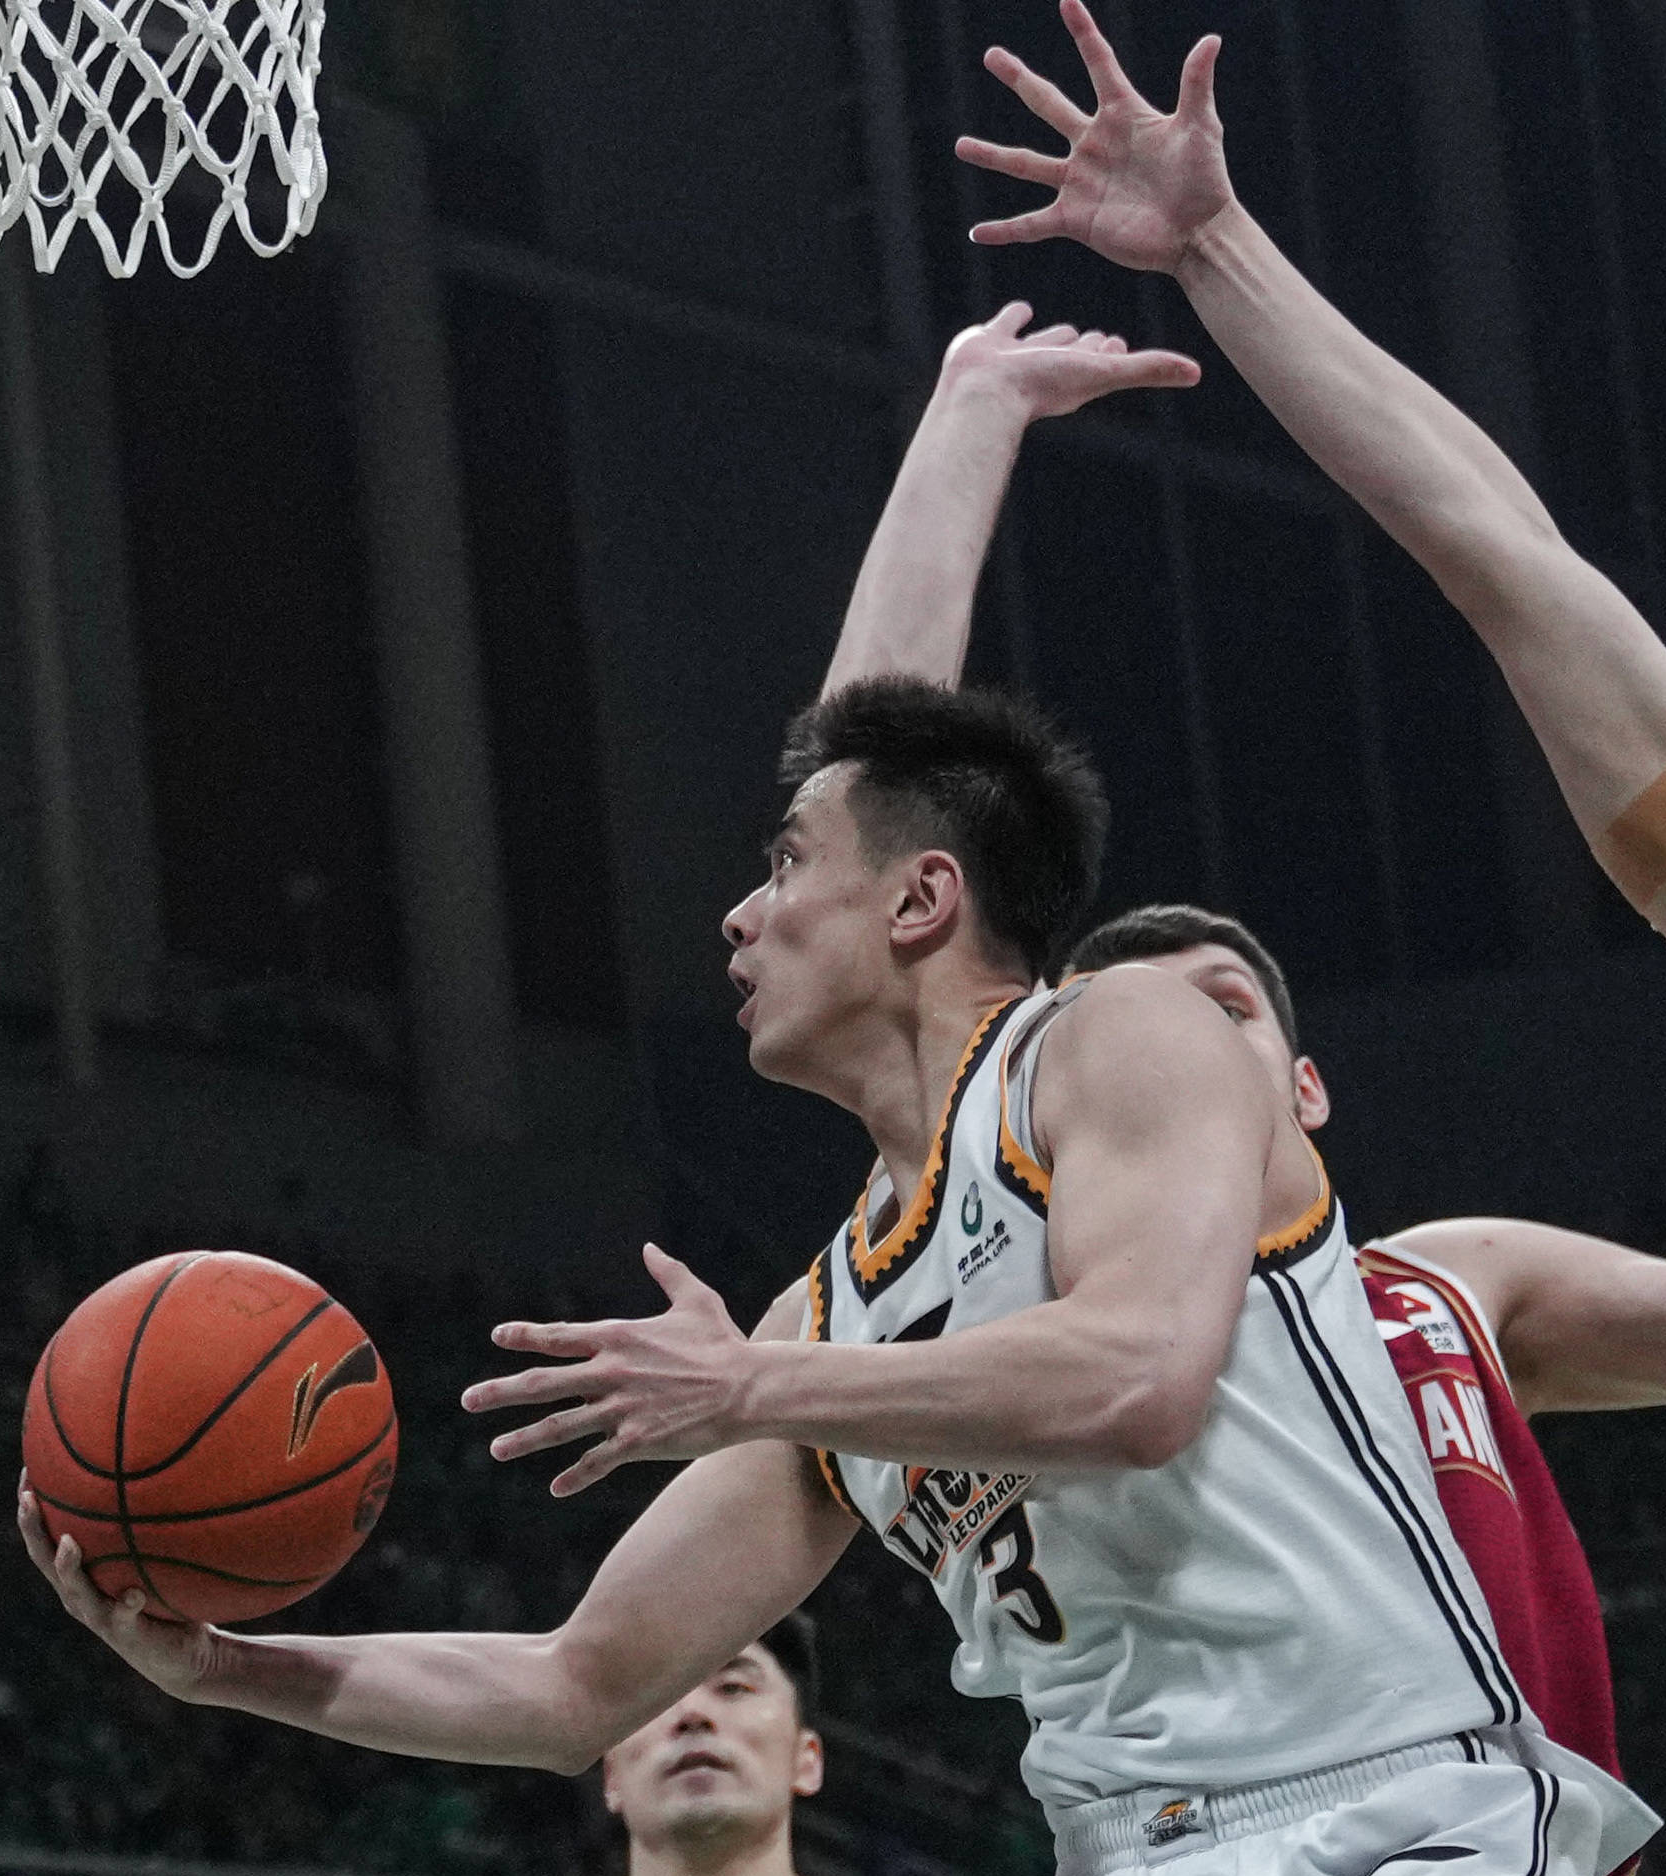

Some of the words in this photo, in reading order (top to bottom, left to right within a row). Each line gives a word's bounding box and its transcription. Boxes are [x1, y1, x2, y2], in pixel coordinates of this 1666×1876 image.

[961, 1256, 993, 1285] CHINA
[992, 1234, 1012, 1258] LIFE
[886, 1469, 991, 1574] LIAO
[949, 1472, 1027, 1543] LEOPARD
[979, 1501, 1067, 1645] 3
